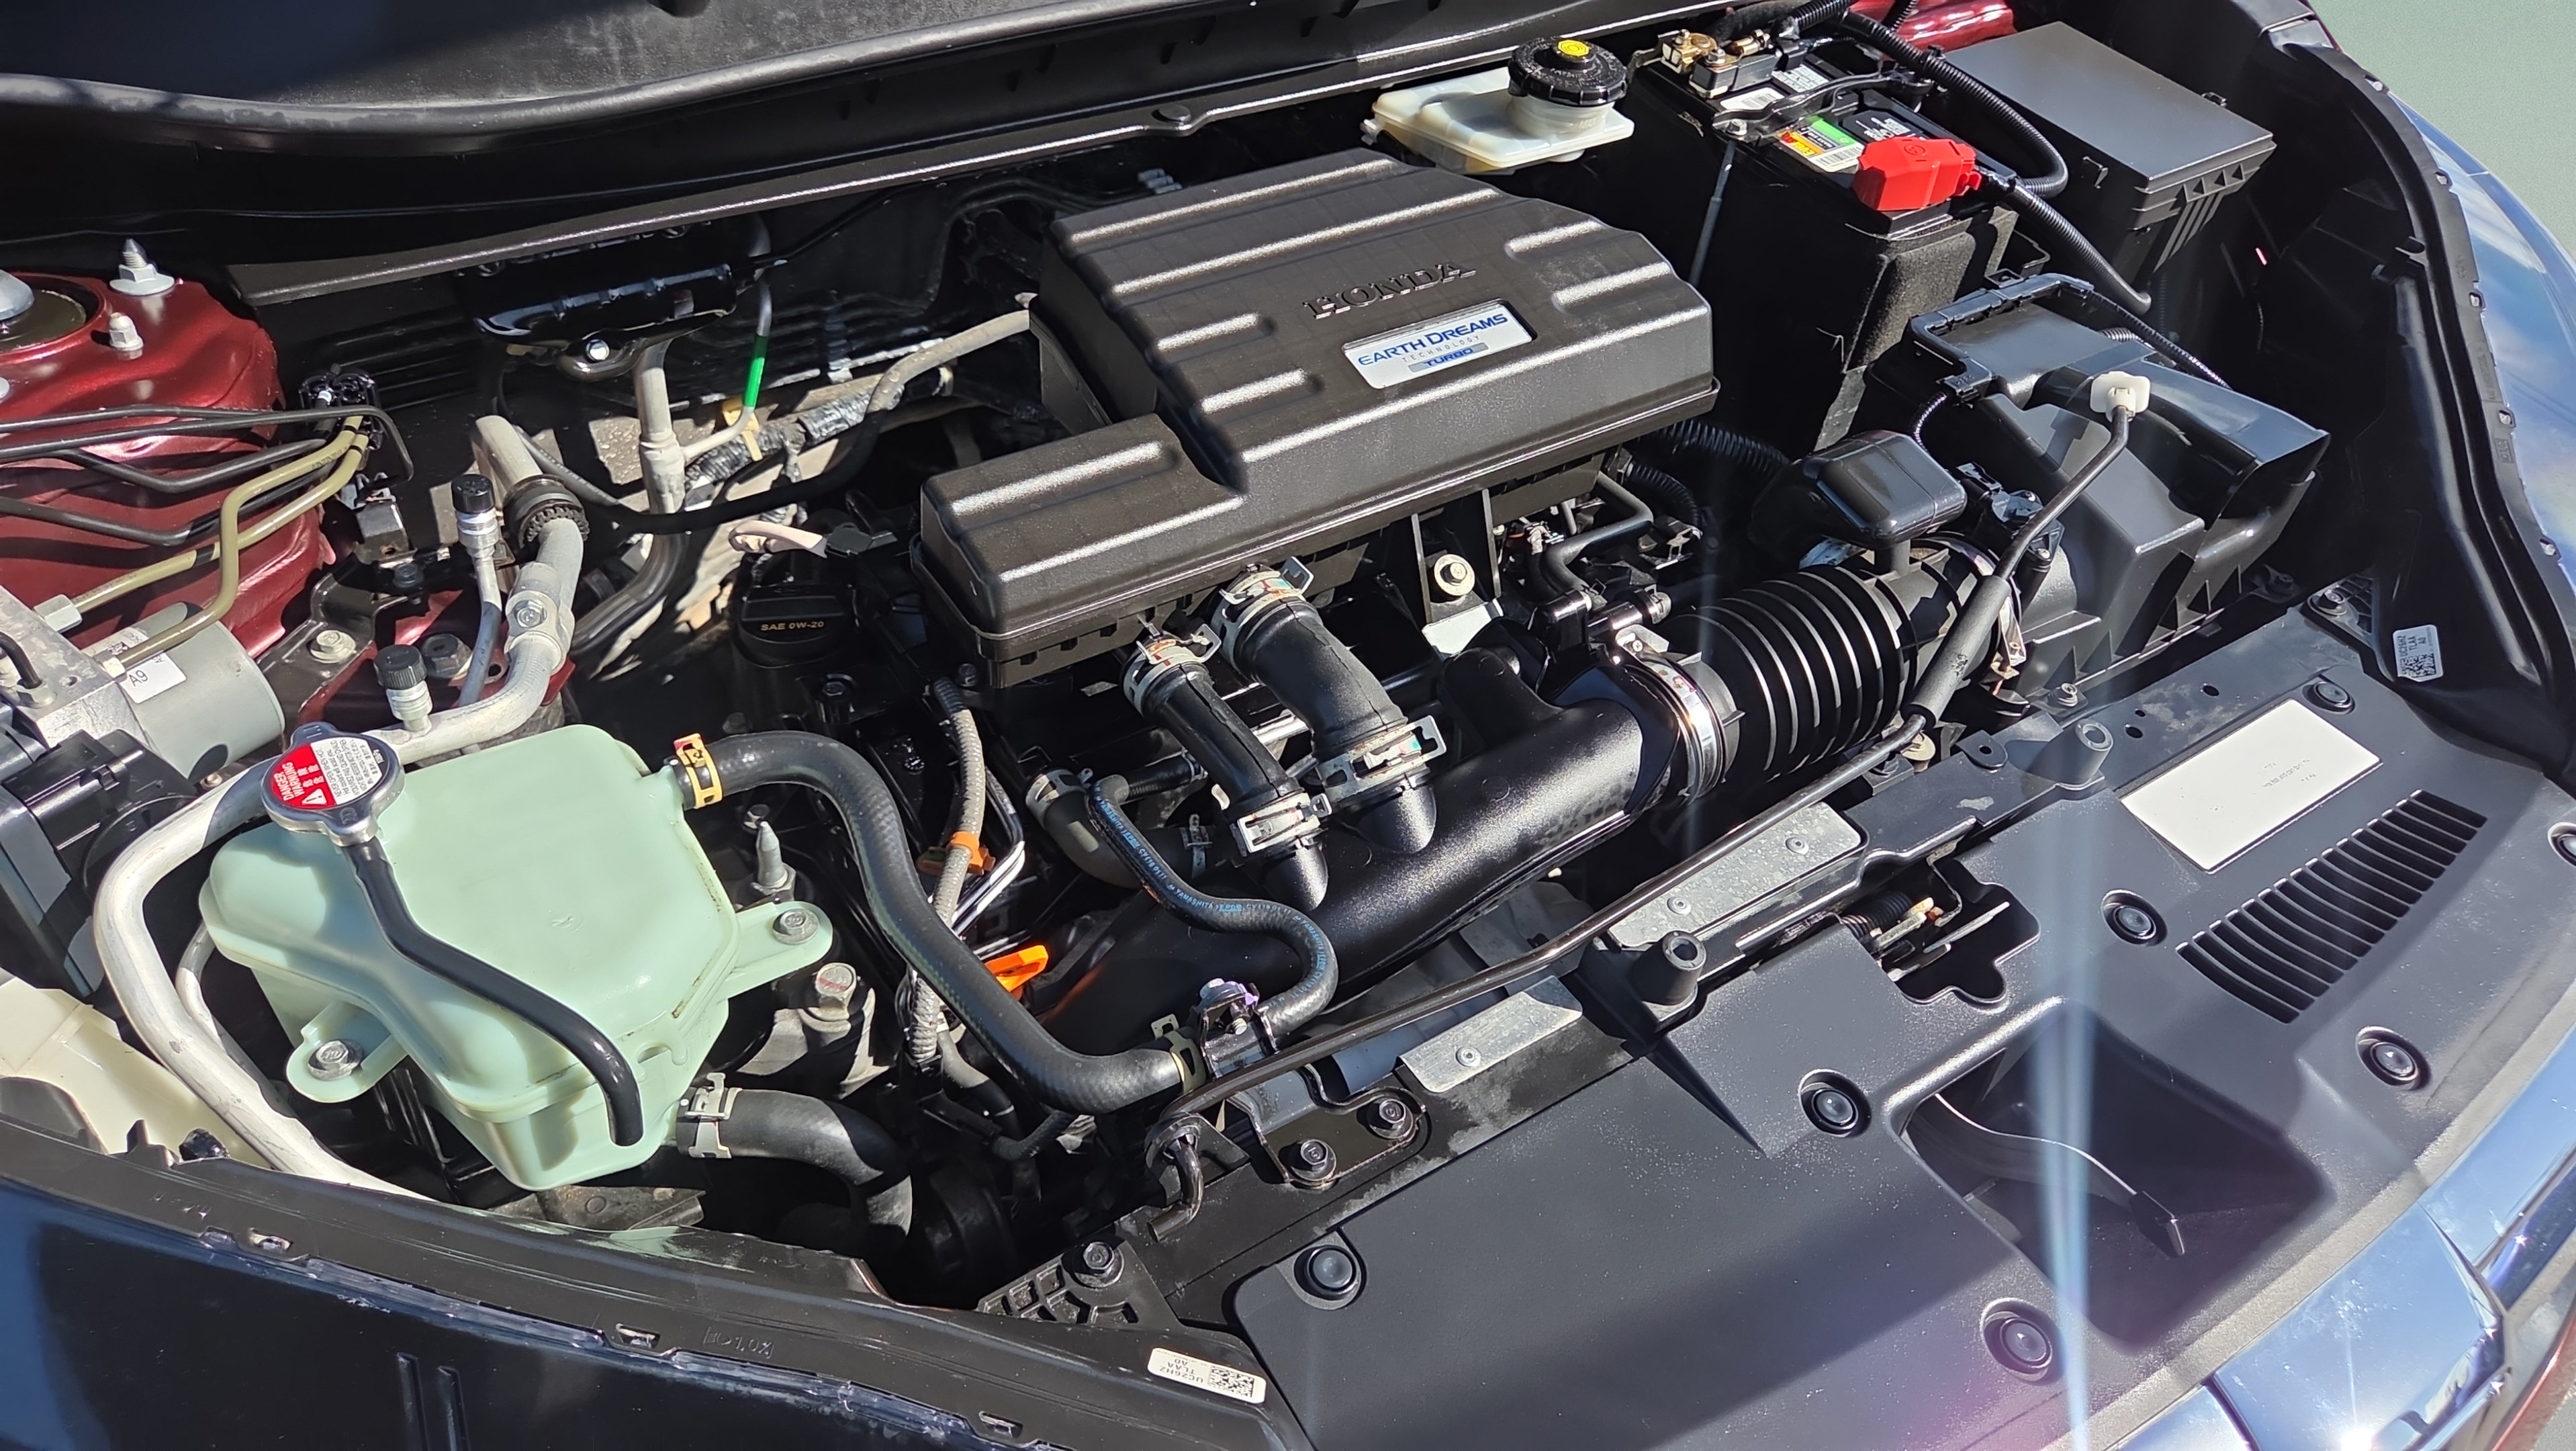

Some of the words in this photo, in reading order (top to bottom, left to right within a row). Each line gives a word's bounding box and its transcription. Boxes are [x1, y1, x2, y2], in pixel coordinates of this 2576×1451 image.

[1303, 263, 1477, 320] HONDA
[1358, 337, 1426, 366] EARTH
[1427, 313, 1509, 346] DREAMS
[1401, 335, 1480, 363] TECHNOLOGY
[1424, 347, 1473, 367] TURBO
[760, 623, 786, 631] SAE
[788, 620, 825, 630] 0W-20
[2407, 635, 2417, 650] TLAA
[128, 669, 148, 687] A9
[273, 770, 294, 801] DANGER
[281, 761, 305, 797] WARNUNG
[1173, 887, 1213, 910] YAMASHITA
[1158, 1365, 1203, 1382] UC26HZ
[1166, 1362, 1195, 1374] TLAA
